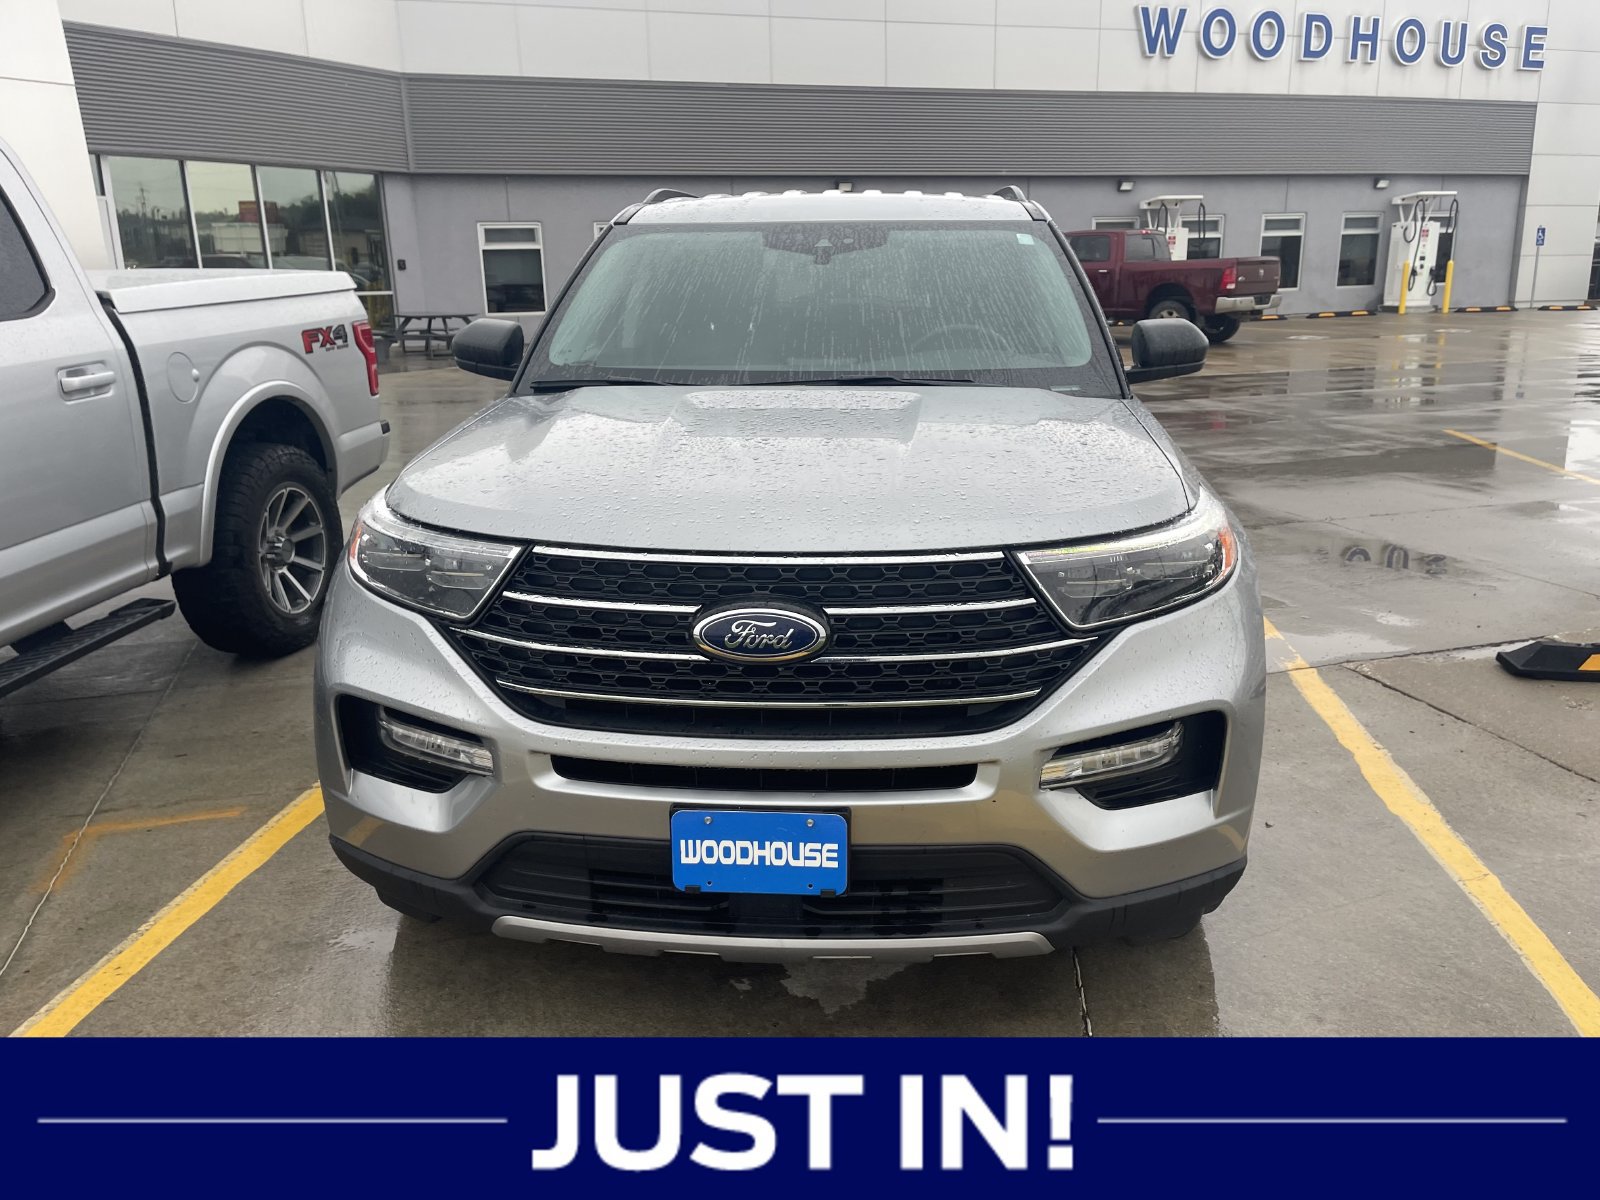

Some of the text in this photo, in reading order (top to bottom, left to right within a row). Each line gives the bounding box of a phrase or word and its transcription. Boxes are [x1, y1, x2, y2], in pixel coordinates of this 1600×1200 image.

[1137, 4, 1549, 71] WOODHOUSE
[301, 323, 348, 354] FX4
[724, 619, 794, 650] Ford
[680, 839, 839, 869] WOODHOUSE
